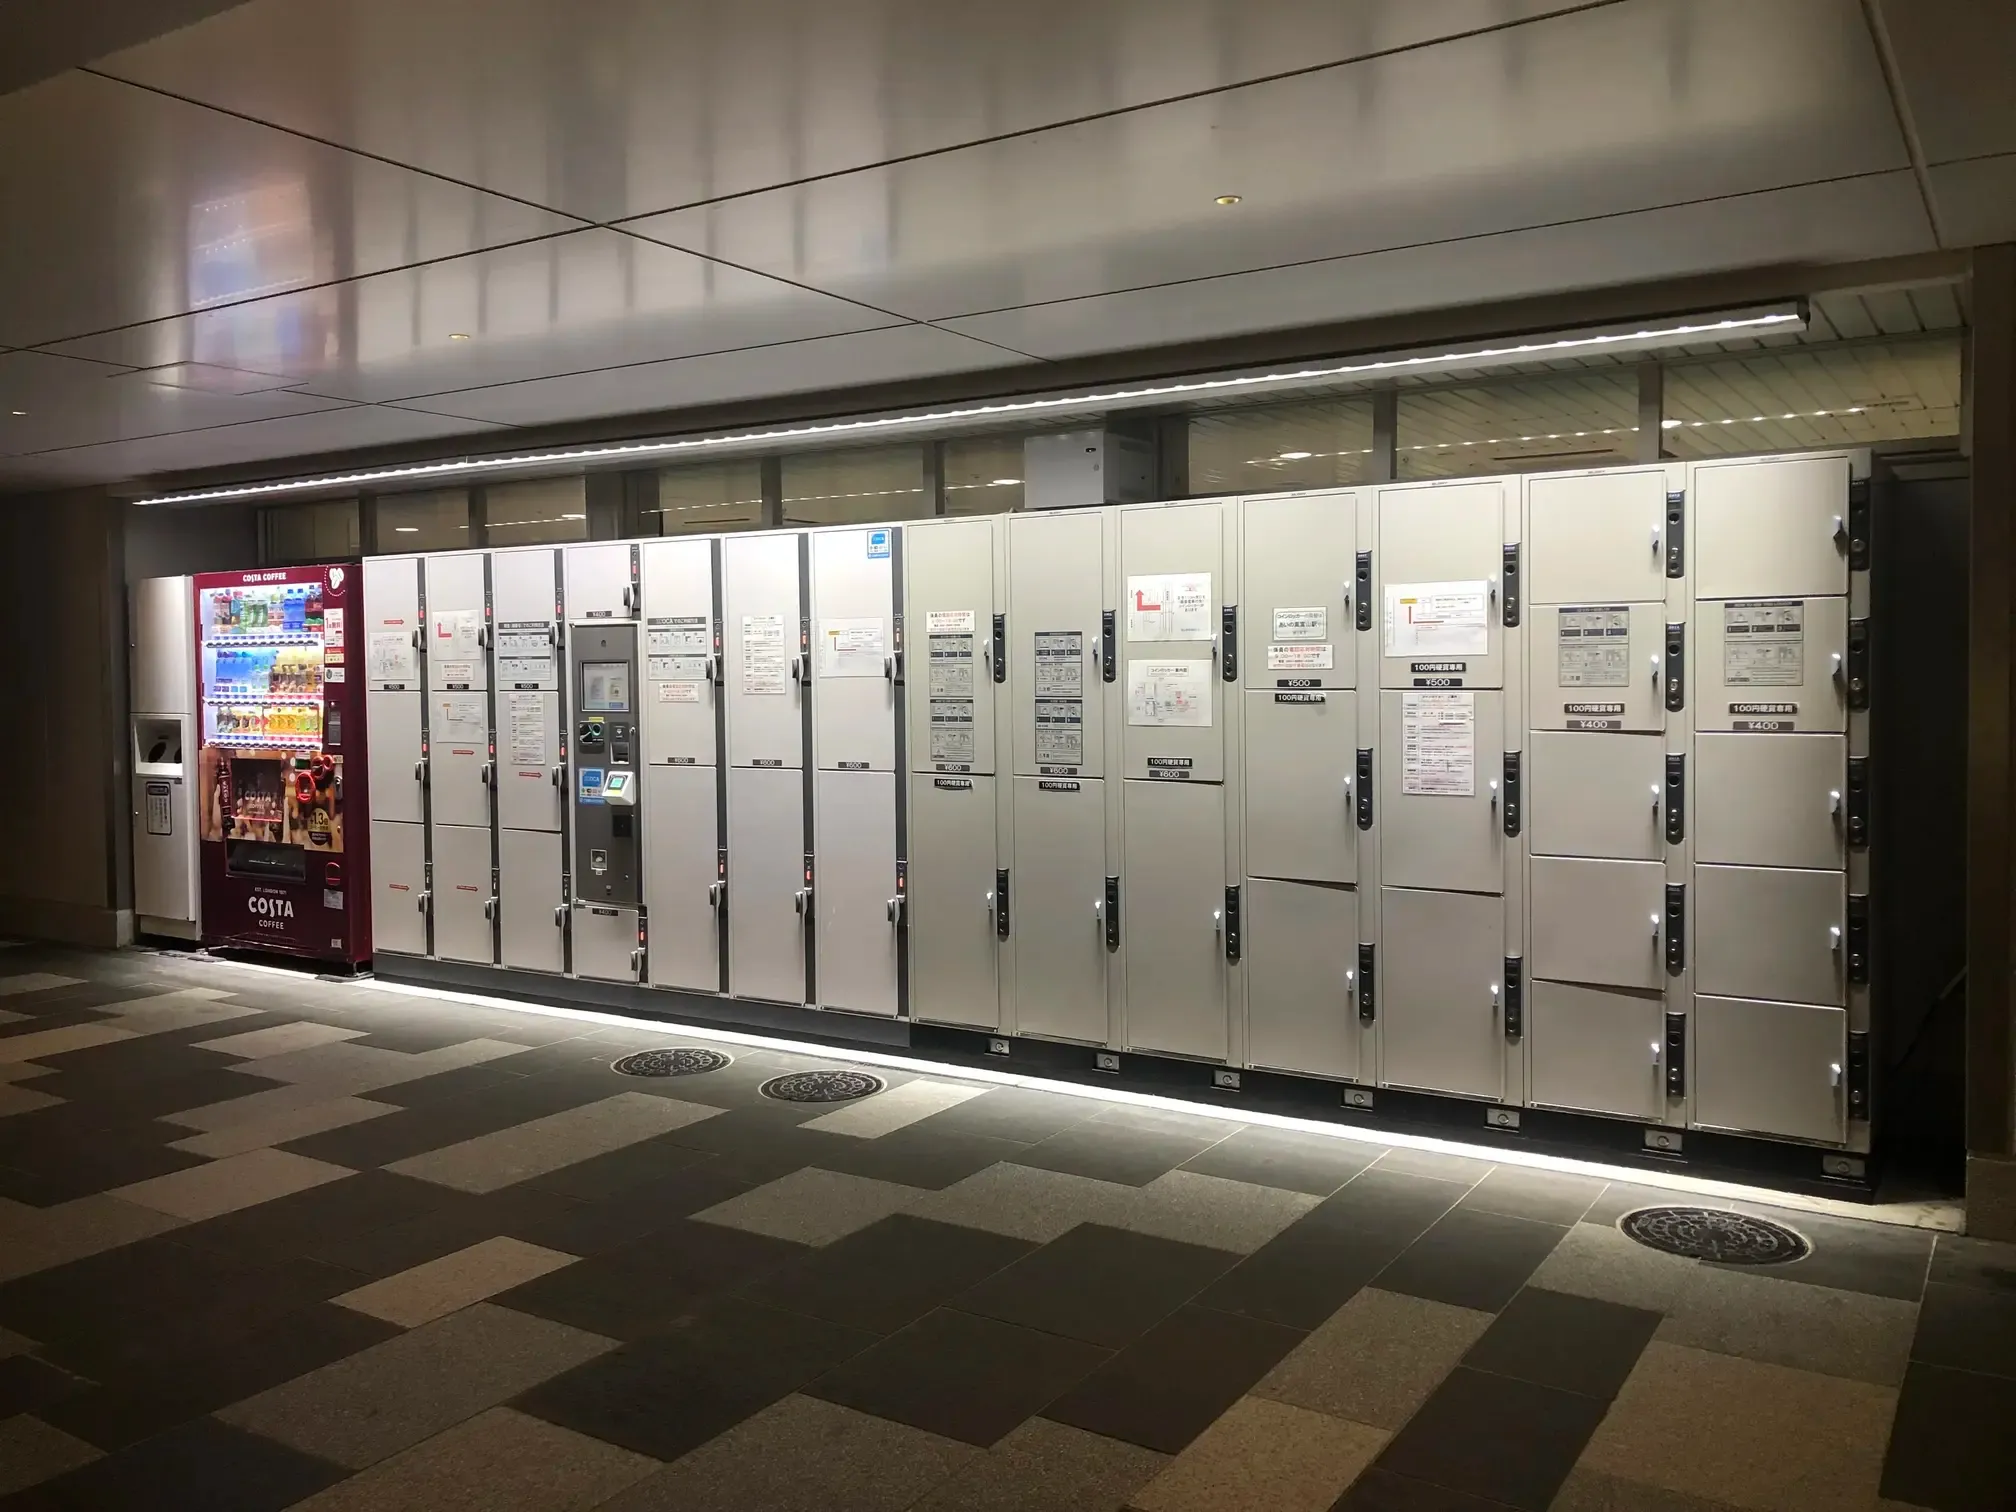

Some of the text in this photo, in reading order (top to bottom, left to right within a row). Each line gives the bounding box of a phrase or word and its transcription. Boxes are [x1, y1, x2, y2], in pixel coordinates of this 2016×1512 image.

[242, 572, 287, 582] COSTA COFFEE
[1288, 679, 1311, 687] ¥500
[1425, 678, 1451, 686] ¥500
[1568, 704, 1622, 713] 100円硬貨専用
[1733, 704, 1793, 713] 100円硬貨専用
[1580, 720, 1608, 729] ¥400
[1748, 721, 1779, 730] ¥400
[1151, 758, 1190, 766] 100円硬貨専用
[1050, 767, 1069, 775] ¥600
[1159, 770, 1180, 778] ¥600
[244, 790, 272, 803] COSTA
[248, 896, 294, 918] COSTA
[258, 919, 284, 930] COFFEE
